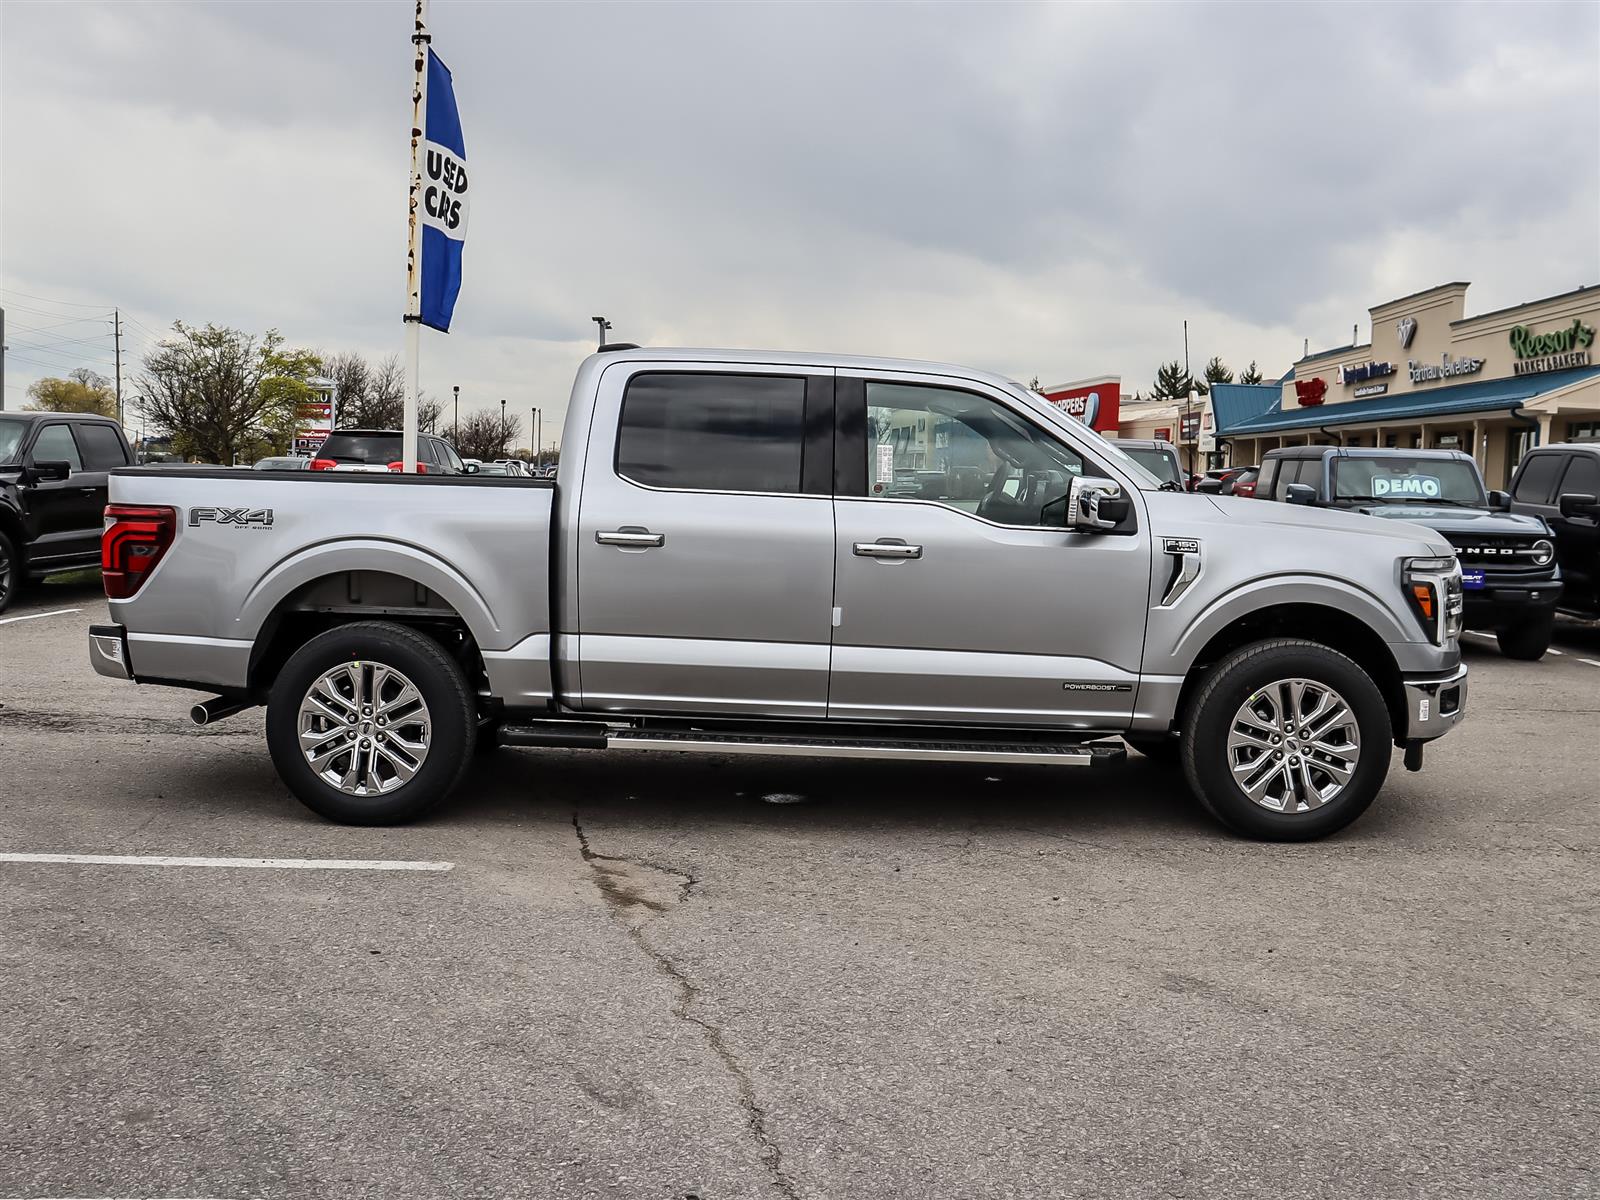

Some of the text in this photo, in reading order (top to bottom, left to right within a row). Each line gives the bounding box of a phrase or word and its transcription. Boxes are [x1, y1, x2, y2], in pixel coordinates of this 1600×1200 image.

[427, 149, 468, 194] USED
[424, 185, 462, 230] CARS
[1509, 319, 1592, 359] Reesor's
[1052, 398, 1085, 413] OPPERS
[1374, 479, 1438, 496] DEMO
[188, 507, 273, 527] FX4
[1167, 540, 1198, 548] F-150
[1454, 547, 1513, 555] ONCO
[1064, 683, 1117, 691] POWERBOOST
